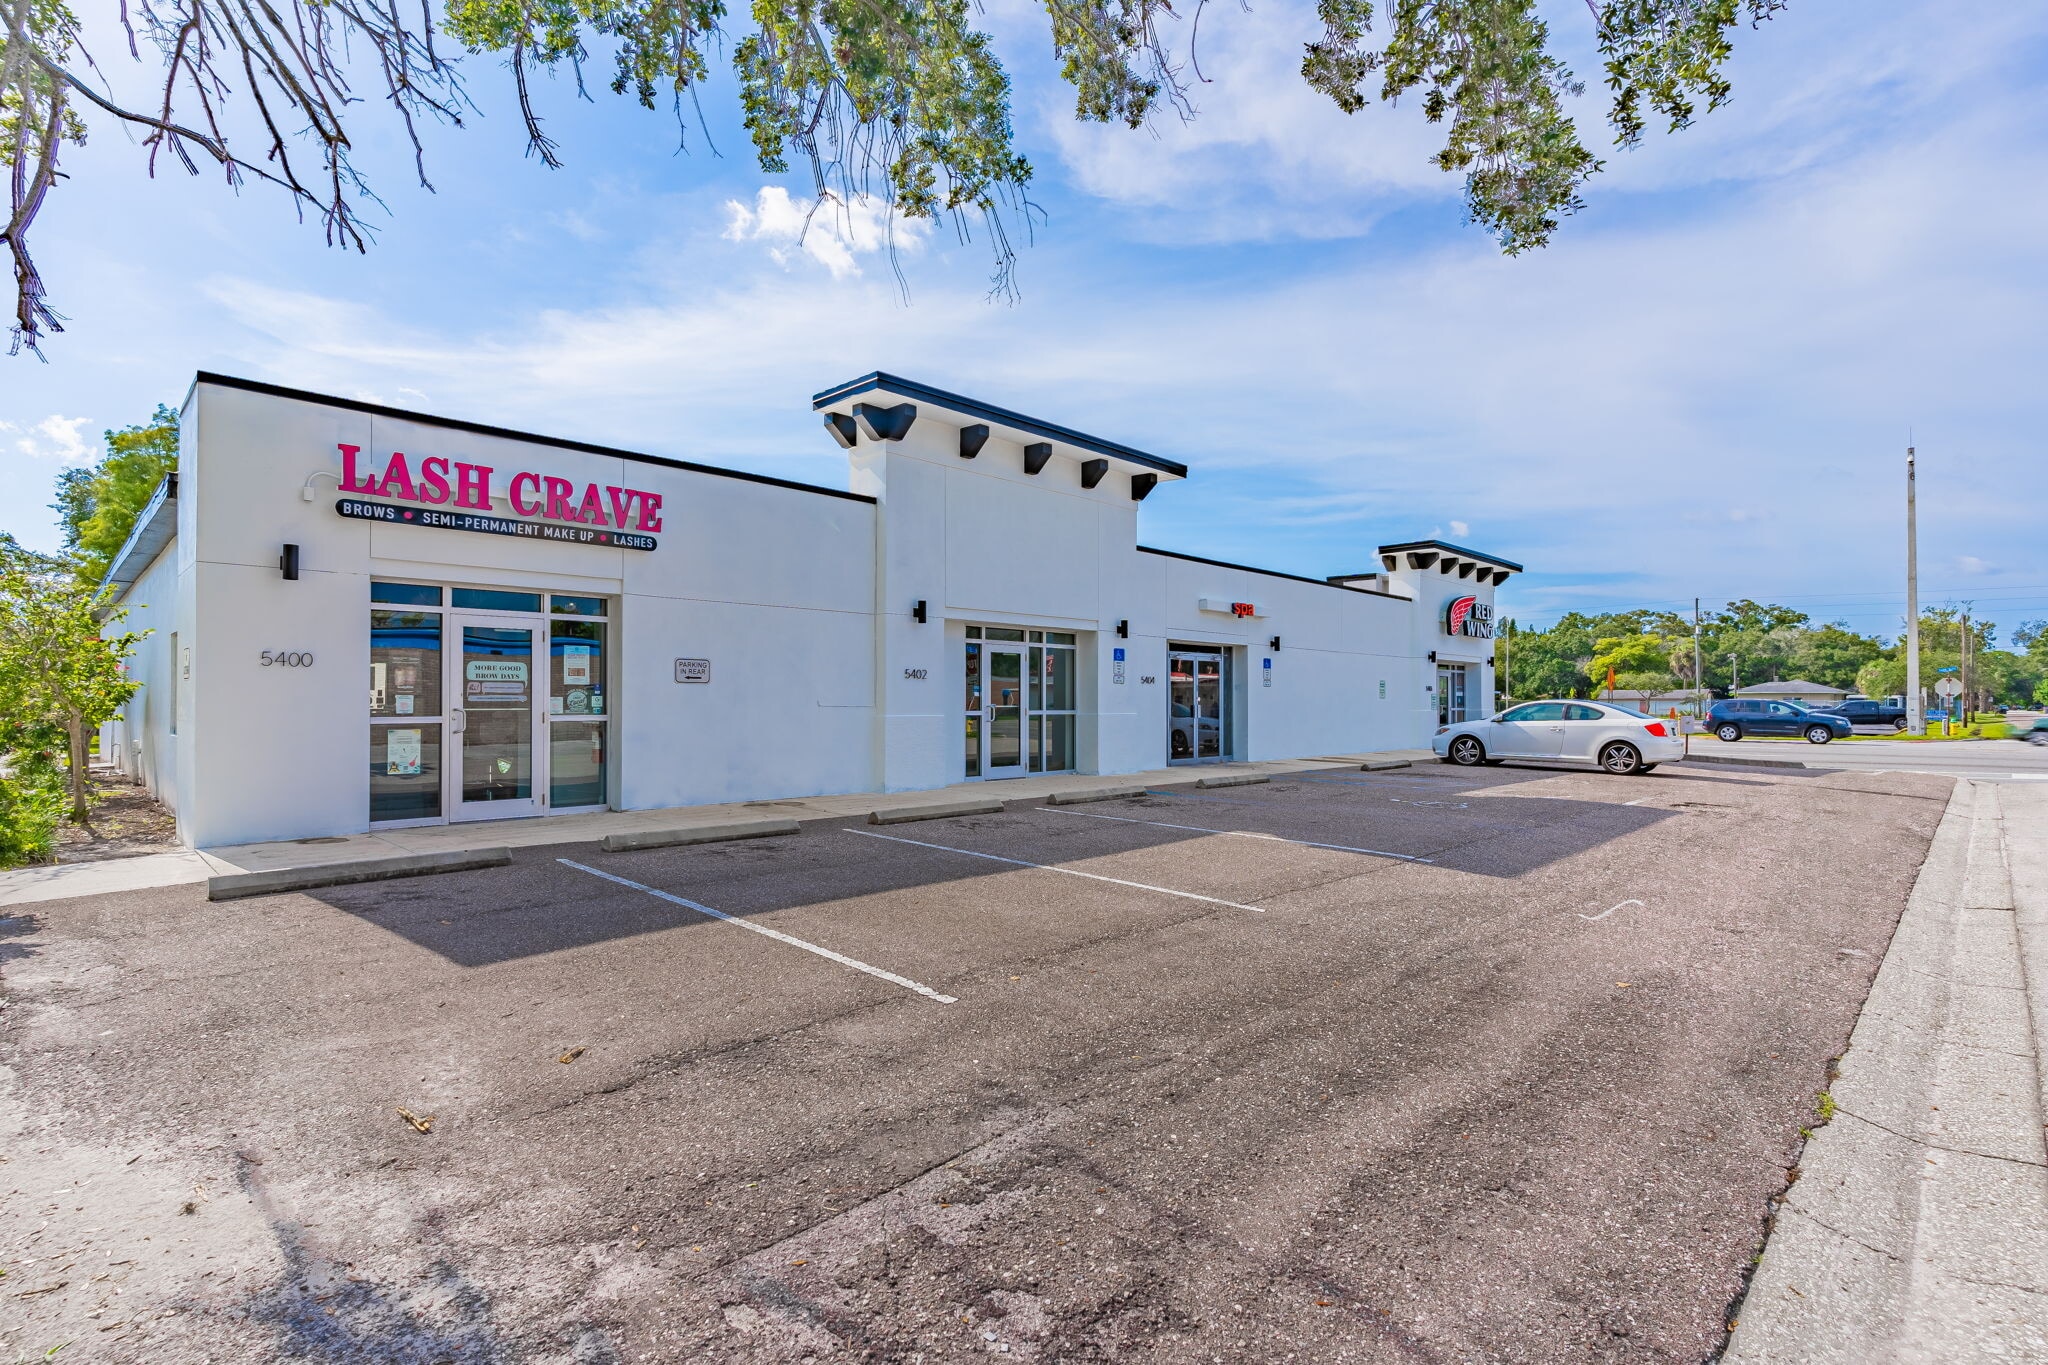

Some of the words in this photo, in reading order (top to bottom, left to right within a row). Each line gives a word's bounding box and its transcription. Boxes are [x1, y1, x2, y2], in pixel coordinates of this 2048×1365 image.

[337, 443, 493, 511] LASH
[509, 471, 663, 533] CRAVE
[343, 502, 395, 519] BROWS
[422, 512, 540, 536] SEMI-PERMANENT
[544, 526, 576, 540] MAKE
[579, 530, 595, 542] UP
[613, 534, 654, 548] LASHES
[1234, 602, 1254, 618] spa
[1475, 603, 1493, 620] RED
[1466, 621, 1494, 639] WING
[261, 651, 313, 667] 5400
[679, 661, 707, 669] PARKING
[904, 669, 928, 680] 5402
